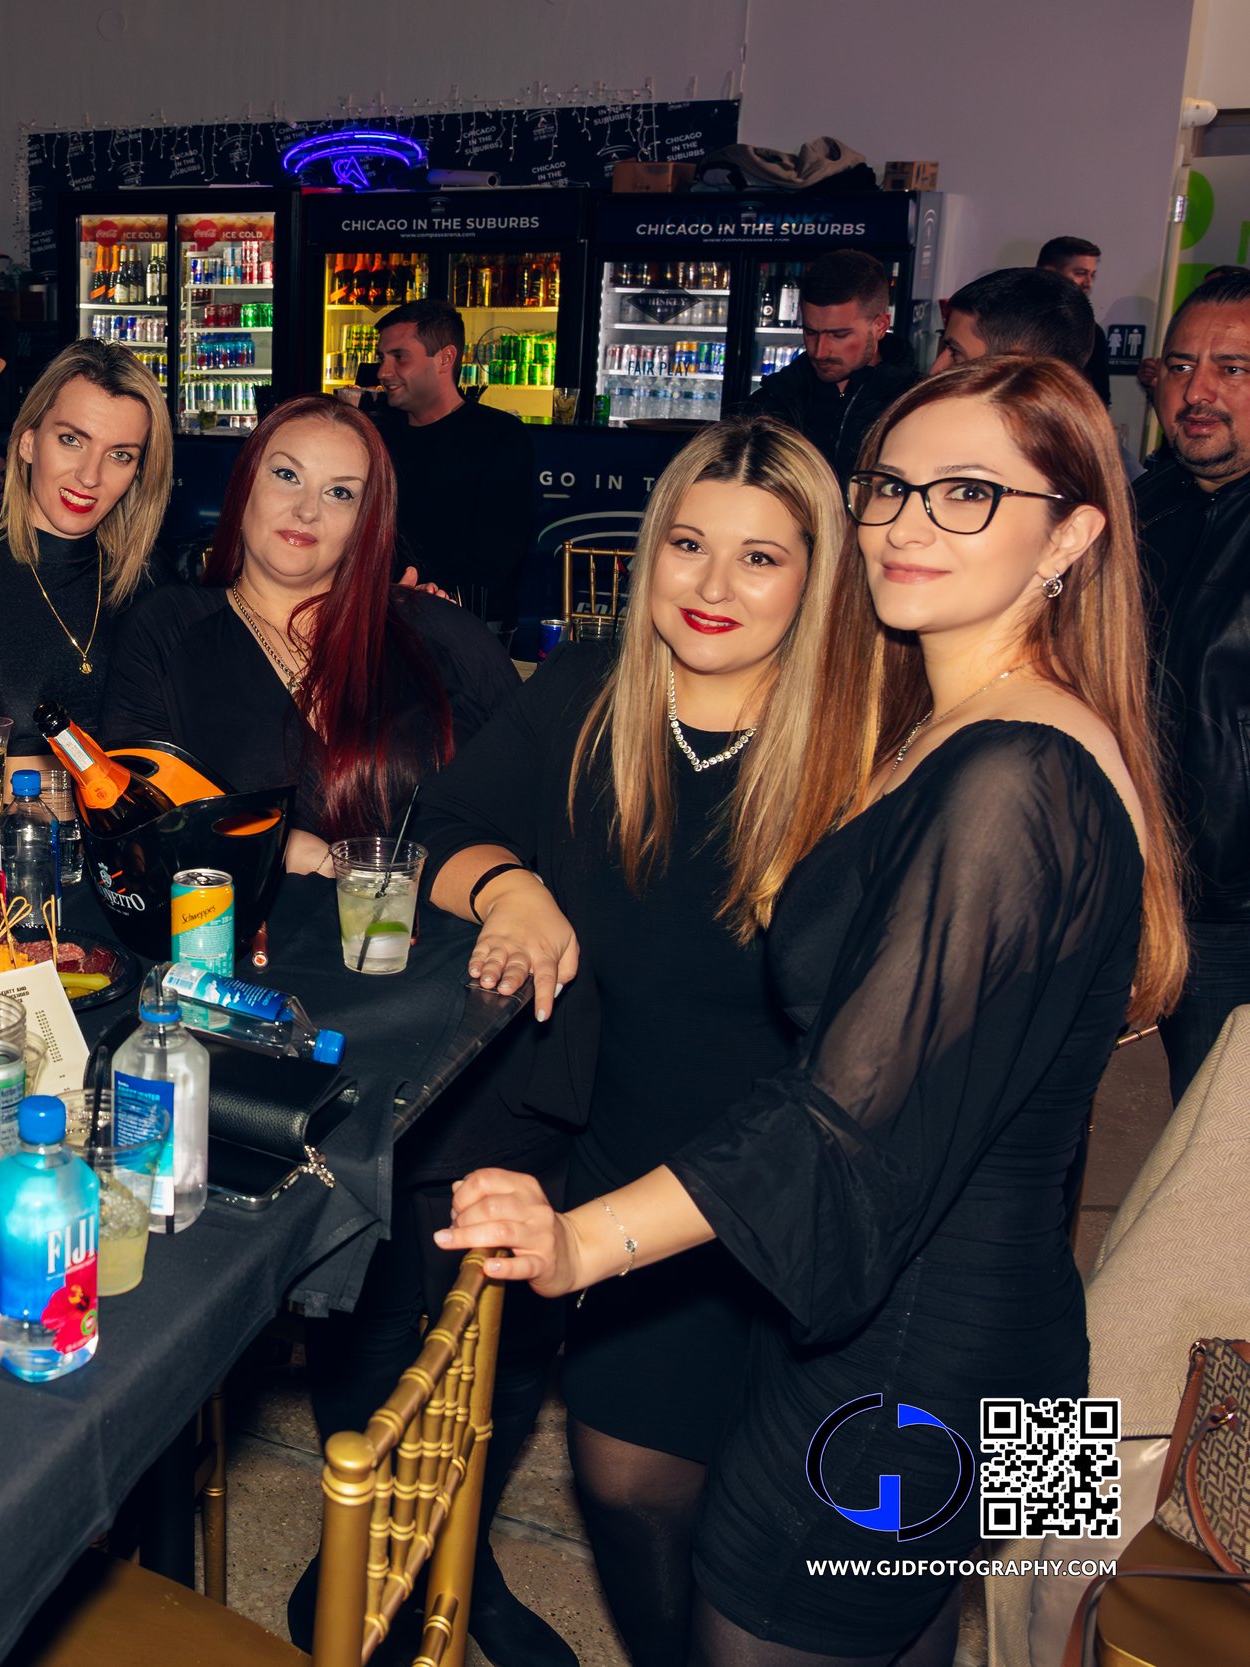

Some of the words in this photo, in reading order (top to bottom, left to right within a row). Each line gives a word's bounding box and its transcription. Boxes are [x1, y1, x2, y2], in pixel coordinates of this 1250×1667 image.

[593, 112, 630, 126] SUBURBS
[463, 125, 497, 139] CHICAGO
[665, 131, 702, 145] CHICAGO
[464, 142, 500, 155] SUBURBS
[681, 141, 698, 150] THE
[666, 148, 705, 161] SUBURBS
[531, 161, 566, 174] CHICAGO
[547, 170, 562, 178] THE
[342, 218, 408, 232] CHICAGO
[412, 218, 428, 231] IN
[432, 218, 461, 230] THE
[466, 216, 540, 230] SUBURBS
[636, 223, 713, 236] CHICAGO
[718, 224, 735, 235] IN
[741, 223, 774, 235] THE
[780, 223, 866, 236] SUBURBS
[123, 231, 137, 240] ICE
[139, 231, 161, 240] COLD
[222, 231, 237, 239] ICE
[239, 230, 262, 239] COLD
[628, 360, 655, 376] FAIR
[659, 362, 692, 377] PLAY
[539, 471, 576, 488] GO
[595, 474, 623, 490] IN
[182, 905, 216, 924] Schweppes
[46, 1214, 96, 1275] FIJI
